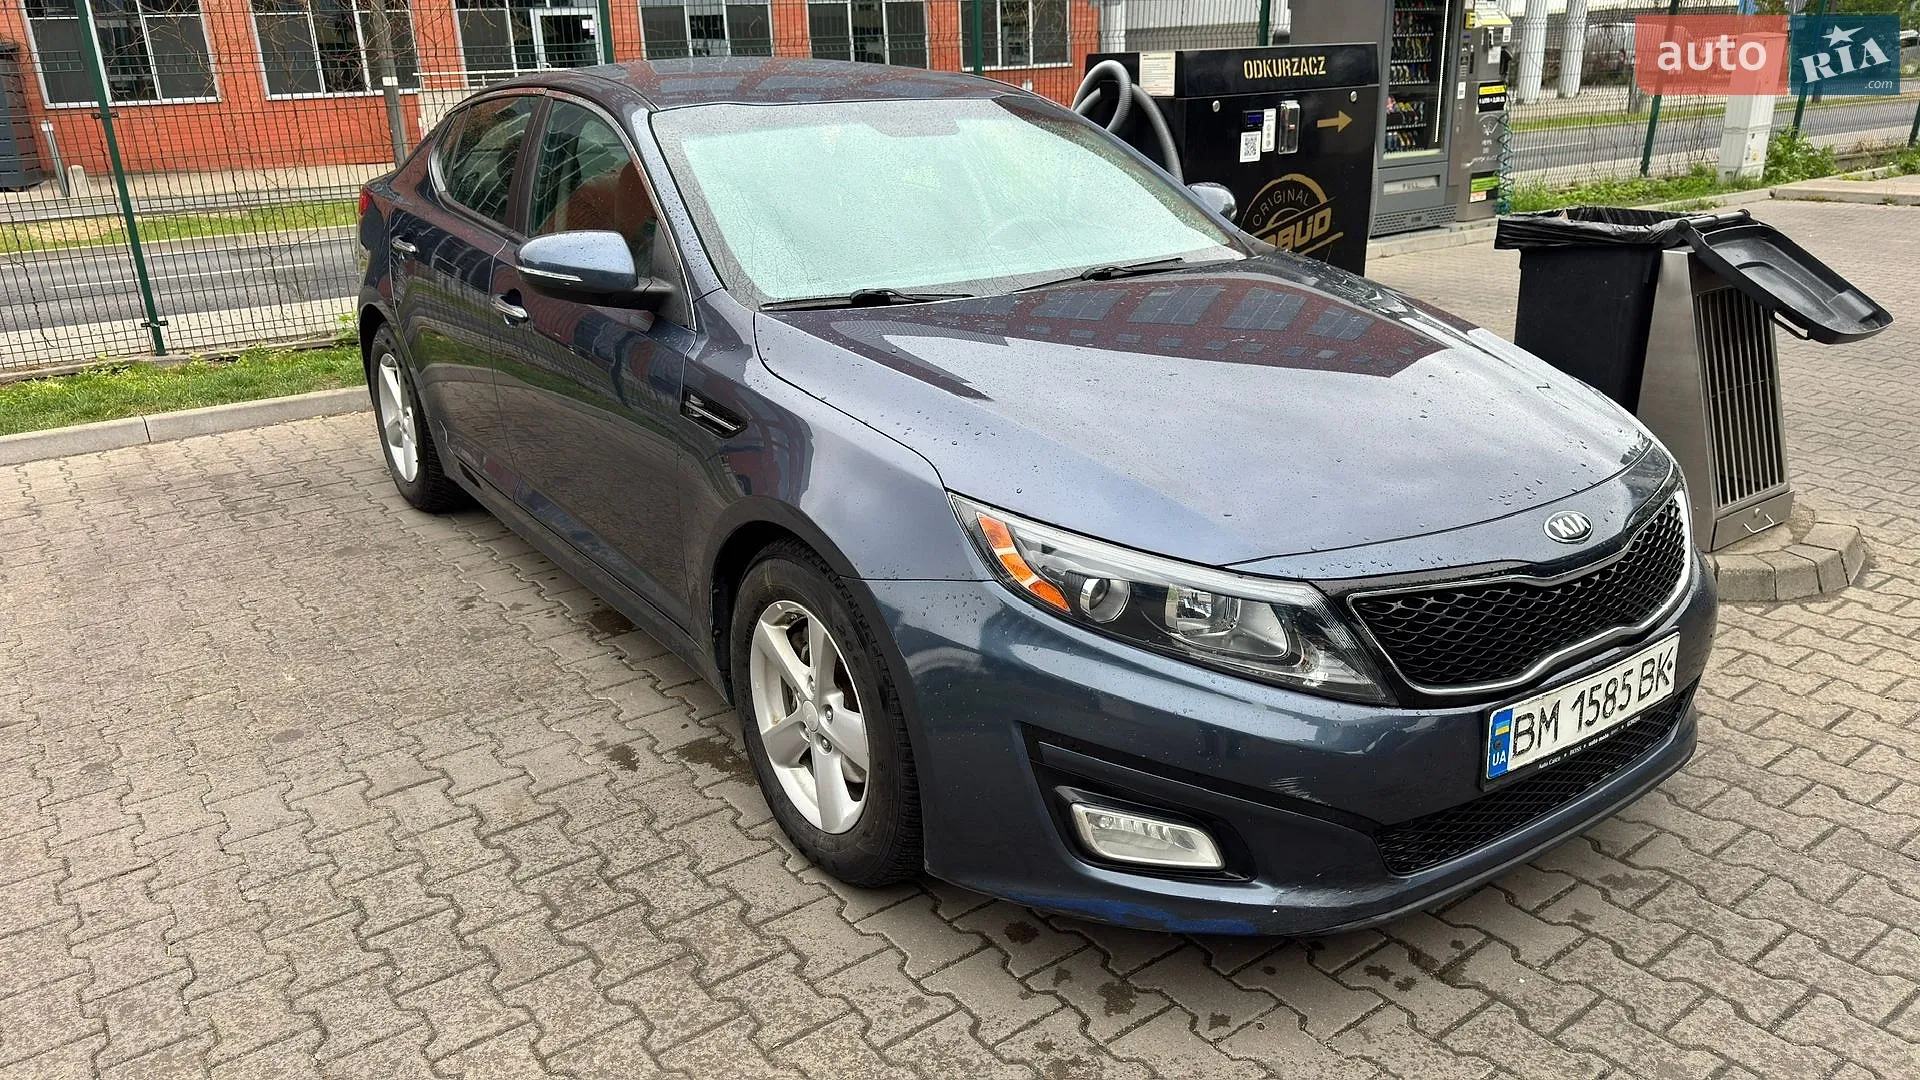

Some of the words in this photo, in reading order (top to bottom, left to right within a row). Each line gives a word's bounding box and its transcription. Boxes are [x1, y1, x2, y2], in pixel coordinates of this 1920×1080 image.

[1243, 56, 1327, 79] ODKURZACZ
[1252, 187, 1310, 227] ORIGINAL
[1550, 513, 1591, 538] KIA
[1512, 700, 1561, 758] BM
[1570, 668, 1634, 733] 1585
[1637, 646, 1675, 702] BK
[1492, 750, 1507, 766] UA
